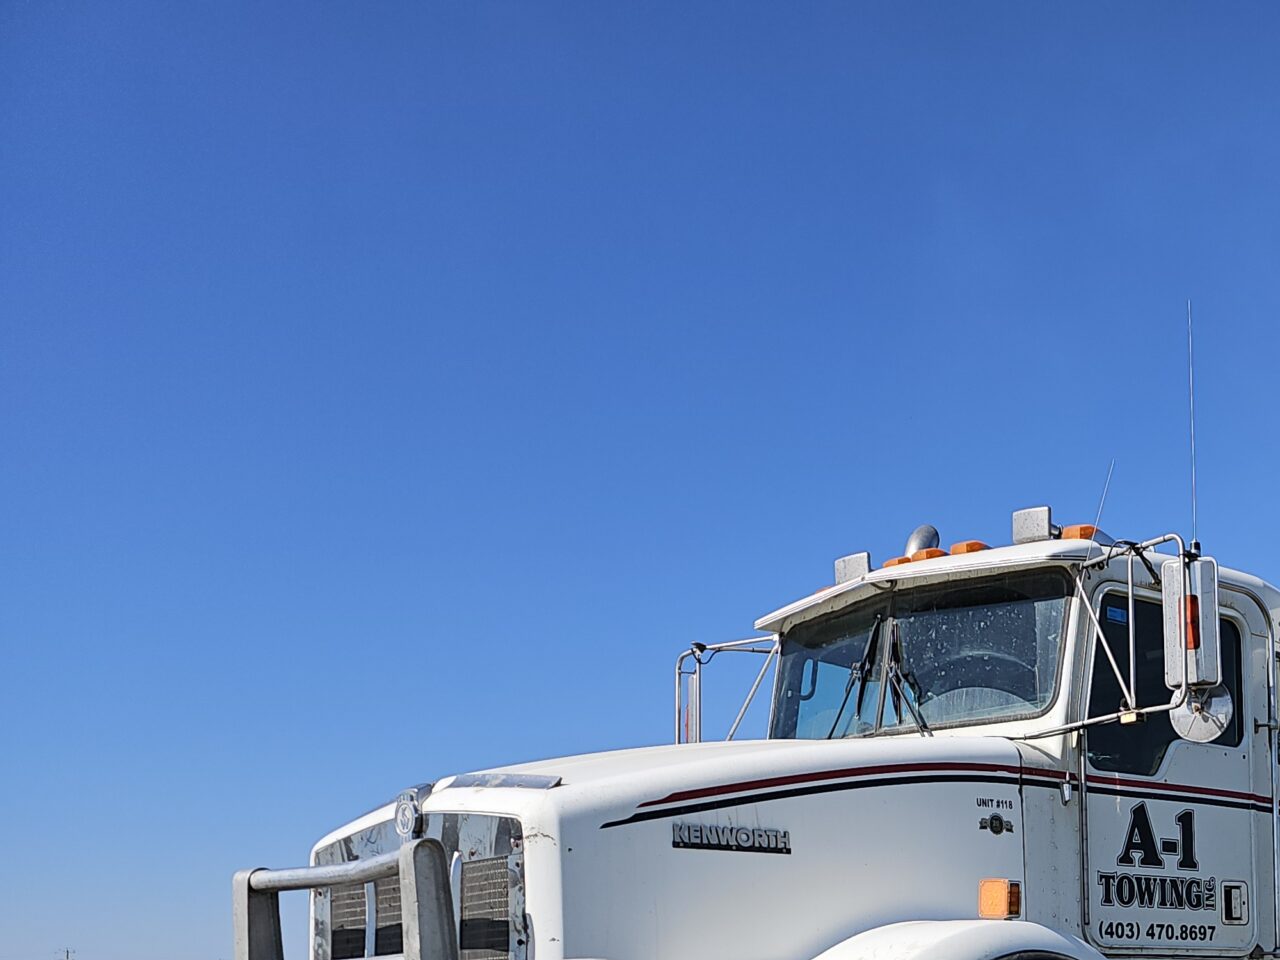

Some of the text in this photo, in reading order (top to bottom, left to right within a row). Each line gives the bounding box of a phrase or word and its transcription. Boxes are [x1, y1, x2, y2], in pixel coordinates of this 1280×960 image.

[976, 797, 994, 808] UNIT
[672, 823, 791, 850] KENWORTH
[1117, 800, 1199, 871] A-1
[1097, 870, 1204, 911] TOWING
[1203, 876, 1216, 911] INC.
[1099, 921, 1217, 941] (403) 470.8697
